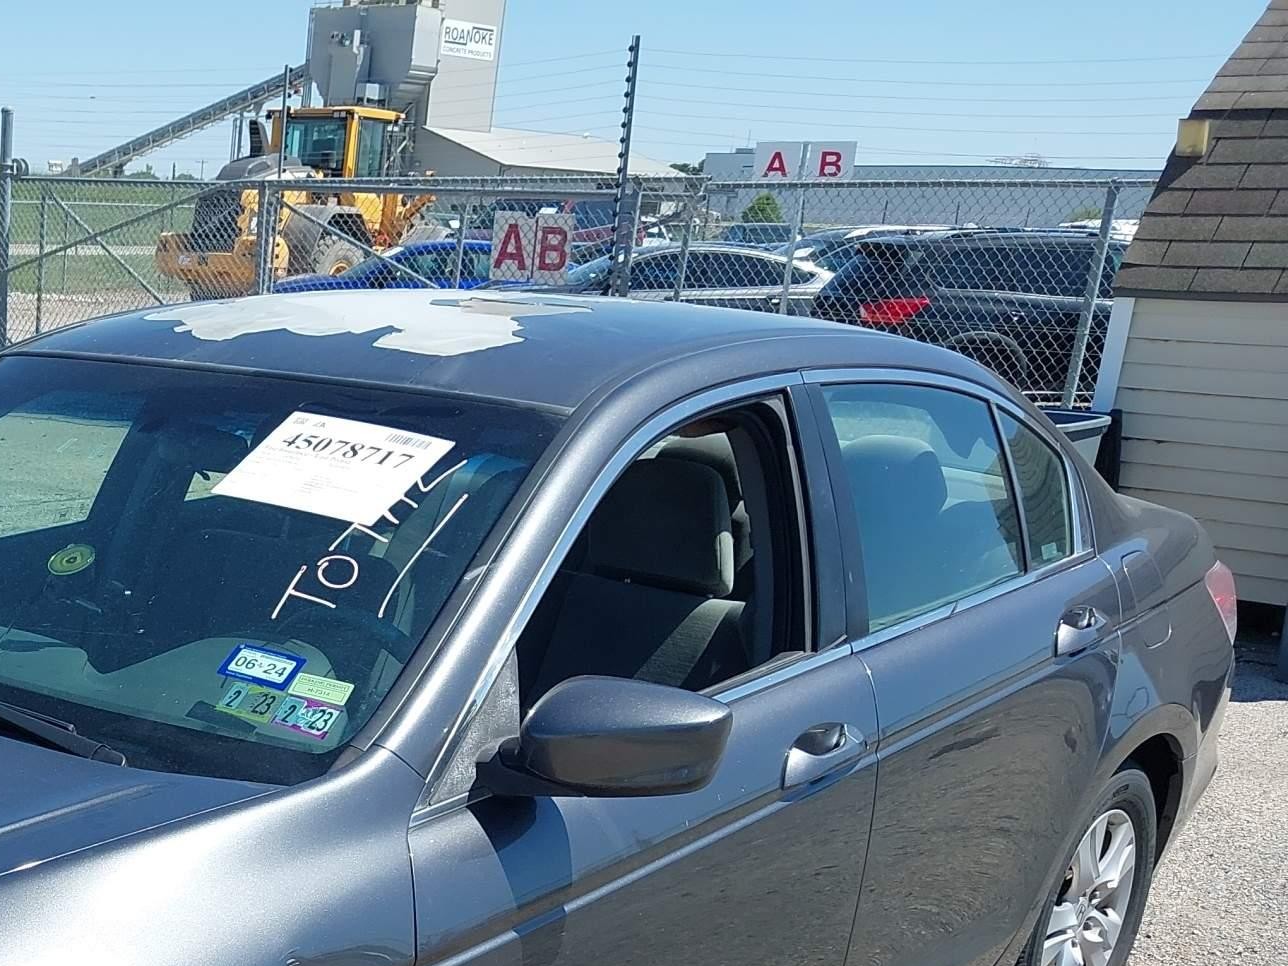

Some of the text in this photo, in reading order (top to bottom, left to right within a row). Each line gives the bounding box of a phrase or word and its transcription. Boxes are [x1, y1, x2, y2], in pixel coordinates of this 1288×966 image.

[444, 25, 494, 46] ROANOKE
[761, 151, 842, 177] A B
[493, 223, 568, 272] A B
[281, 432, 416, 470] 45078717
[234, 656, 257, 670] 06
[262, 662, 288, 678] 24
[226, 690, 276, 716] 2 23
[282, 704, 334, 732] 2 23
